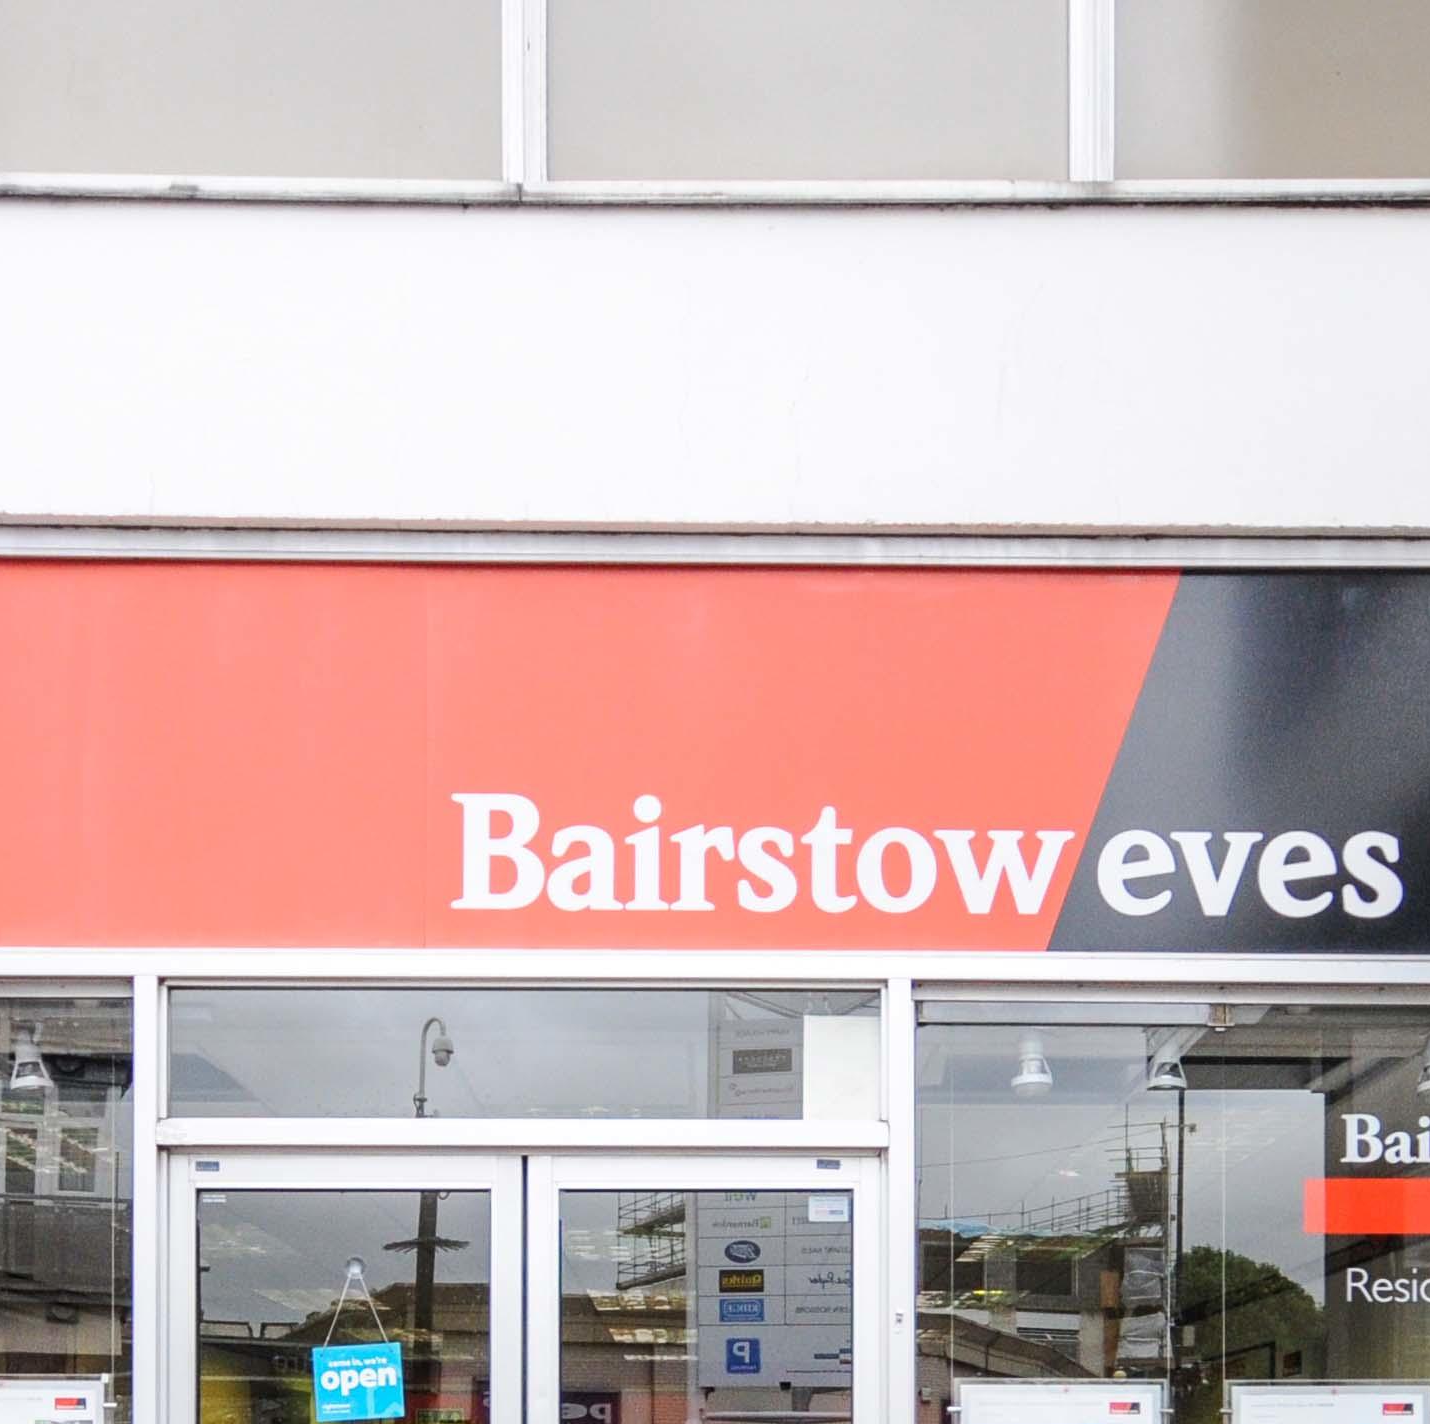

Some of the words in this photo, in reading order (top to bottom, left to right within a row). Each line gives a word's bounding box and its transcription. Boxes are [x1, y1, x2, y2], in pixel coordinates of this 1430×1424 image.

[450, 792, 1077, 916] Bairstow
[1096, 828, 1404, 919] eves
[320, 1366, 398, 1398] open
